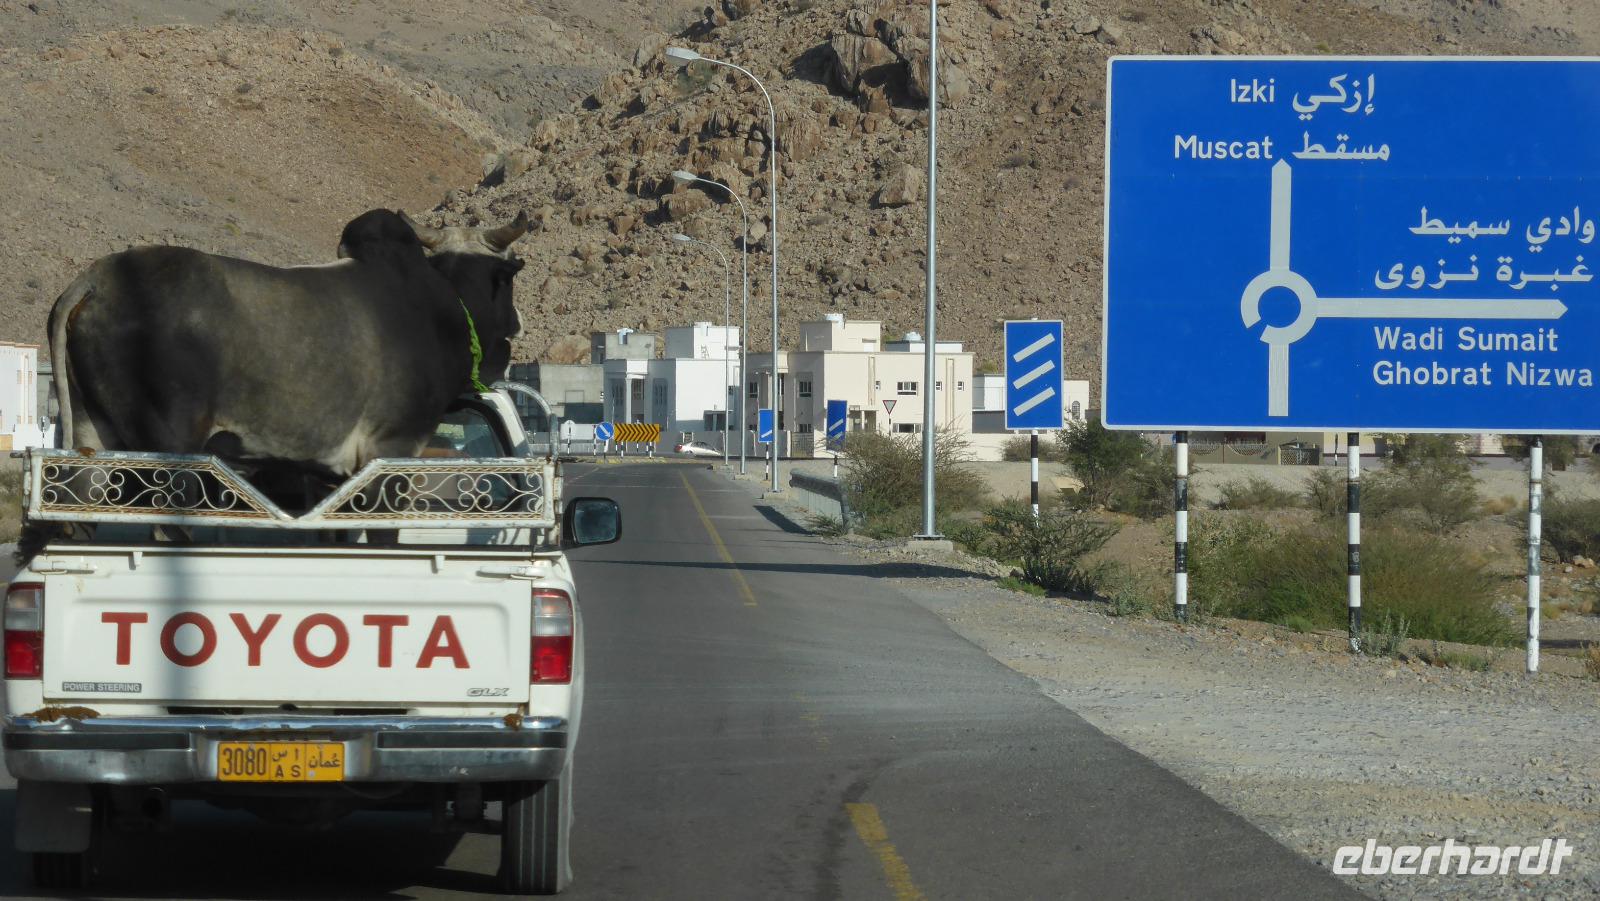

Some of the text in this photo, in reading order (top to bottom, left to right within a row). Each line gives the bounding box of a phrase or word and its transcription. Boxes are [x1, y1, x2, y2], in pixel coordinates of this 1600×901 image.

[1231, 78, 1275, 103] Izki
[1292, 73, 1375, 121] إزكي
[1174, 134, 1273, 160] Muscat
[1292, 131, 1390, 161] مسقط
[1408, 205, 1595, 252] وادي سميط
[1374, 253, 1594, 291] غبرة نزوى
[1374, 326, 1558, 352] Wadi Sumait
[1372, 360, 1593, 387] Ghobrat Nizwa
[101, 611, 470, 669] TOYOTA
[63, 682, 140, 692] POWER STEERING
[467, 687, 510, 697] GLX
[222, 747, 267, 776] 3080
